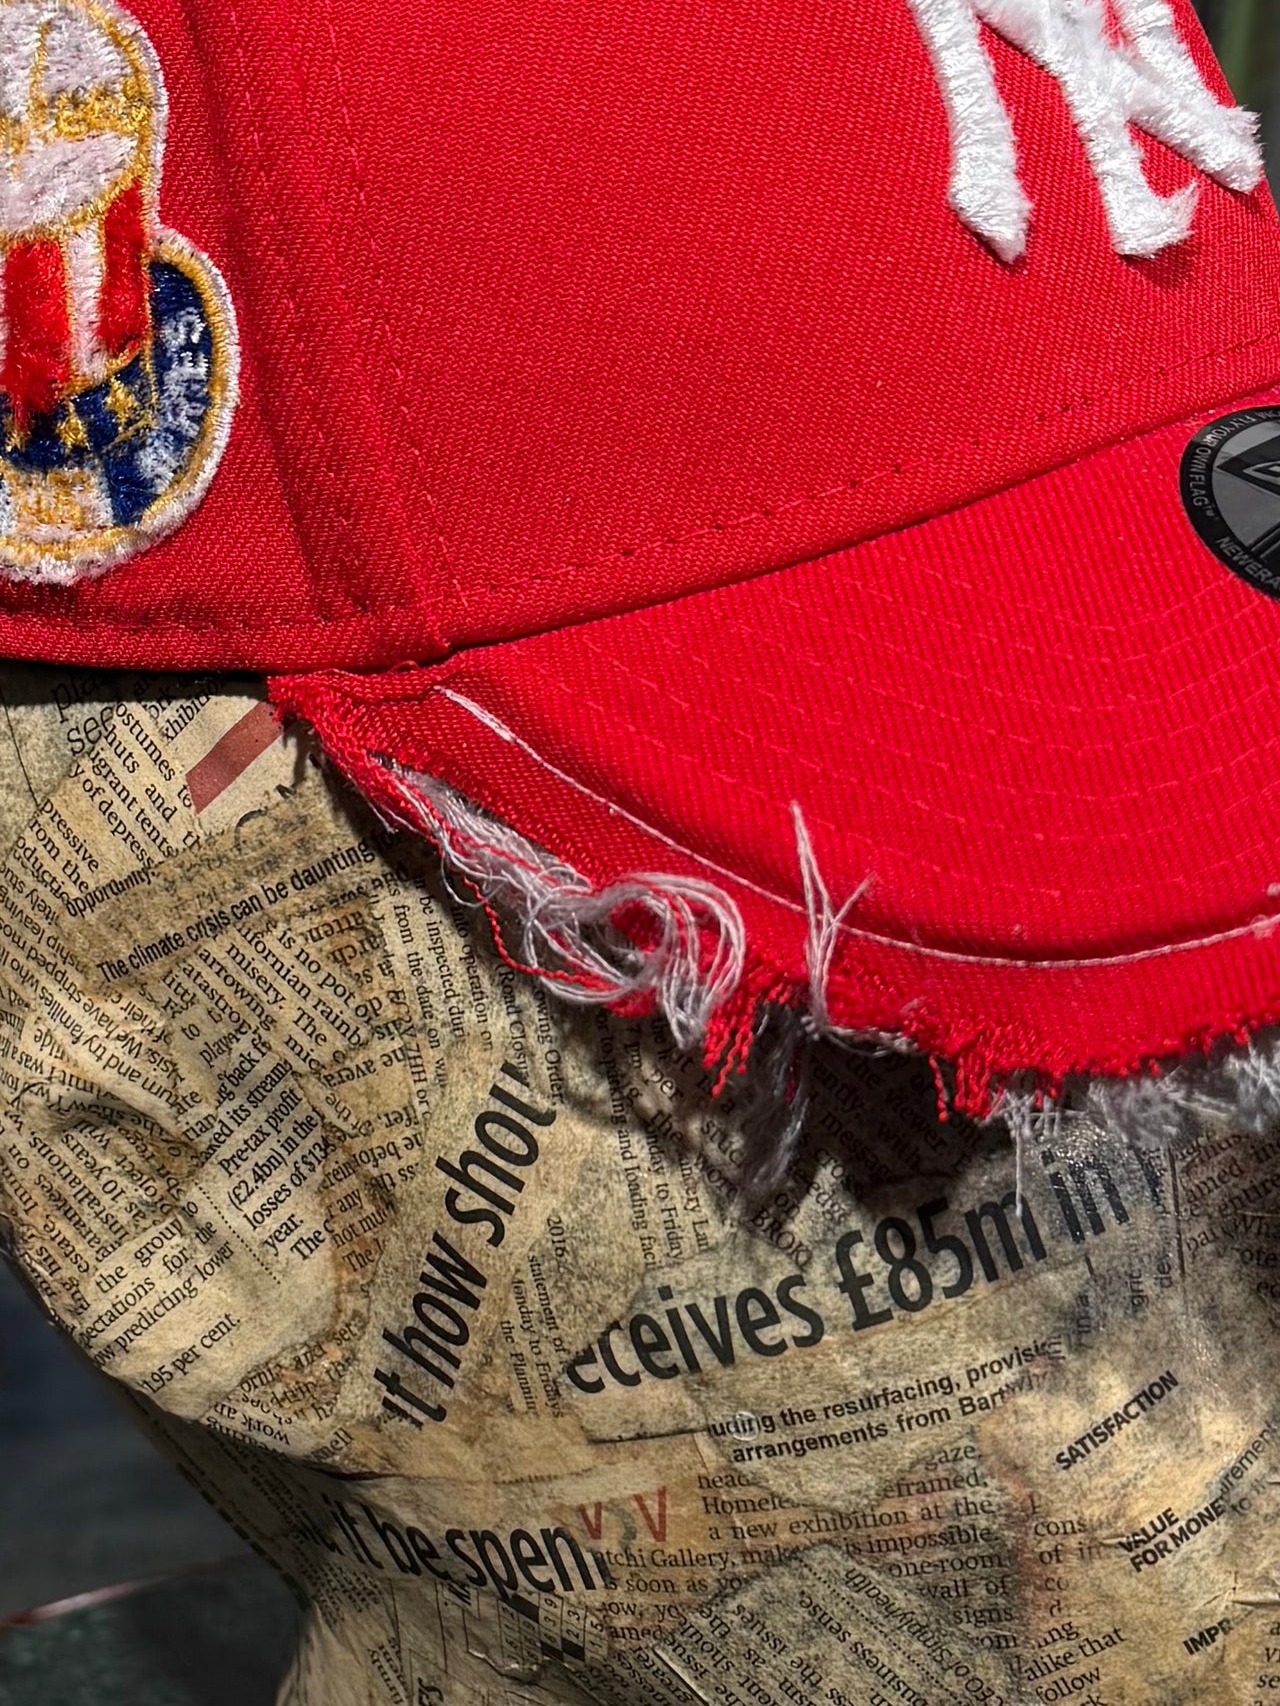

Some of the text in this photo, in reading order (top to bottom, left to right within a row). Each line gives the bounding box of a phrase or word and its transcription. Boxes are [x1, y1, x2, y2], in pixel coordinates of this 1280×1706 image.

[82, 777, 104, 801] of
[144, 783, 178, 823] and
[40, 799, 101, 874] pressive
[136, 805, 178, 859] tents
[61, 856, 92, 895] the
[97, 839, 376, 984] The climate crisis can be daunting
[295, 948, 322, 975] no
[393, 903, 435, 1021] from the date
[425, 920, 455, 1001] inspected
[460, 943, 491, 1026] operation
[38, 984, 86, 1046] families
[225, 942, 328, 1048] misery. The
[494, 963, 520, 1018] (Road
[219, 1088, 304, 1178] Pre-tax profit
[228, 1148, 287, 1212] (£2.4bn)
[616, 1126, 649, 1231] and loading
[243, 1182, 293, 1232] losses
[263, 1211, 305, 1258] year.
[659, 1203, 686, 1265] Friday
[95, 1217, 185, 1294] the group
[162, 1244, 191, 1277] for
[289, 1232, 327, 1264] The
[835, 1189, 1048, 1333] £85m
[1042, 1147, 1132, 1245] in
[113, 1282, 200, 1354] predicting
[381, 1231, 489, 1390] how
[527, 1253, 558, 1334] statement
[170, 1311, 242, 1378] per cent.
[778, 1373, 963, 1428] the resurfacing,
[1054, 1369, 1181, 1472] SATISFACTION
[731, 1405, 953, 1464] arrangements from
[361, 1499, 450, 1581] be
[730, 1495, 996, 1542] new exhibition at the
[867, 1524, 1000, 1559] impossible.
[1117, 1506, 1182, 1556] VALUE
[650, 1545, 740, 1574] Gallery,
[887, 1549, 1006, 1579] one-room
[1038, 1542, 1065, 1567] of
[1129, 1540, 1174, 1575] FOR
[625, 1574, 710, 1595] soon as
[984, 1574, 1011, 1595] of
[698, 1604, 732, 1639] the
[734, 1602, 792, 1659] issues
[798, 1590, 852, 1647] sense.
[952, 1603, 1015, 1627] signs
[790, 1654, 824, 1687] the
[1023, 1626, 1128, 1683] alike that
[1035, 1666, 1104, 1706] follow
